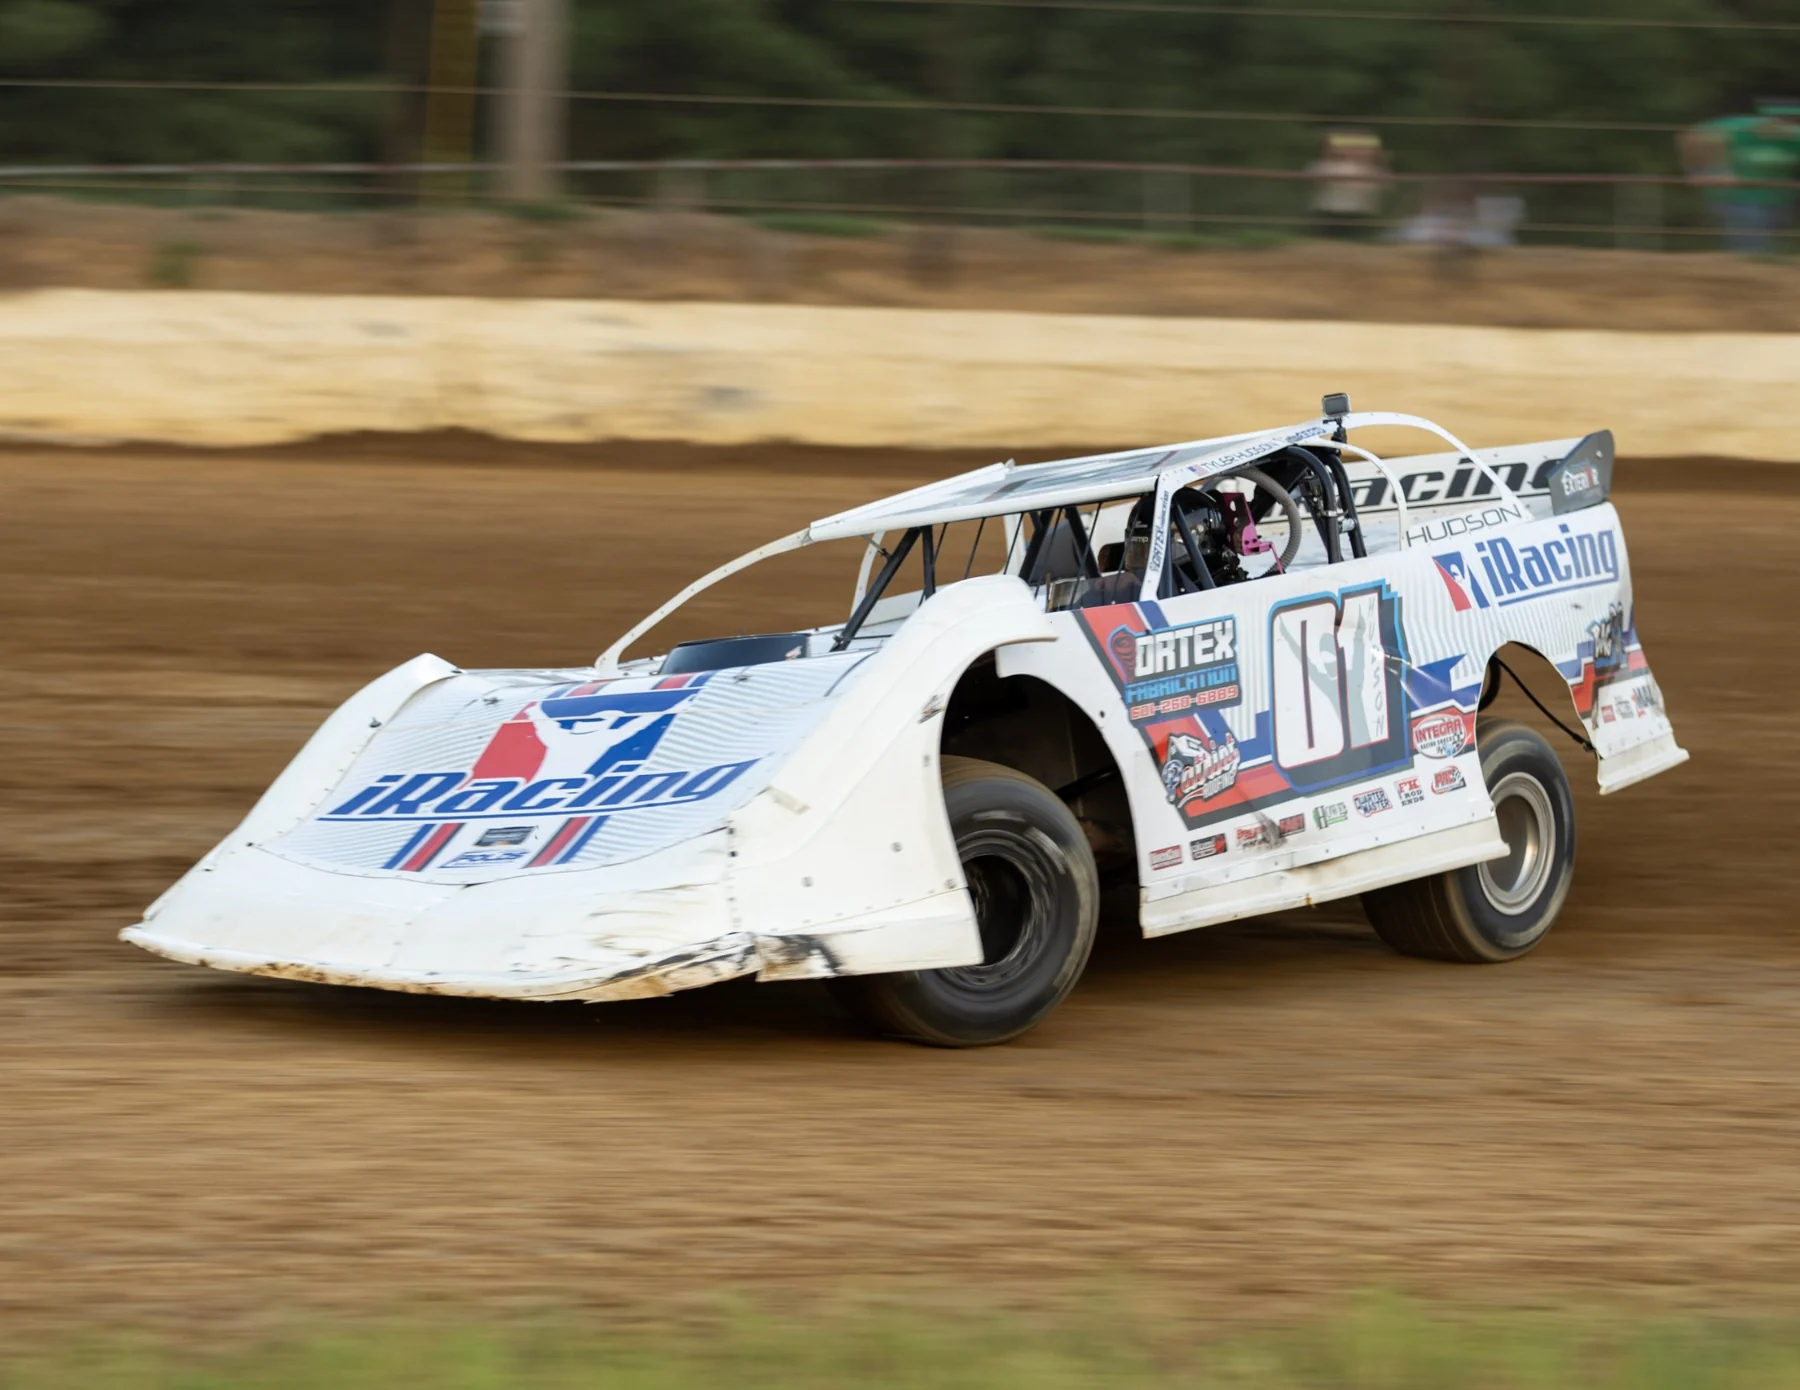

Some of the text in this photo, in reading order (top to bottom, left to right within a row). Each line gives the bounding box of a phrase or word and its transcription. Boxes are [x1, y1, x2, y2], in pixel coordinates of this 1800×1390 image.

[1405, 503, 1522, 548] HUDSON
[1474, 523, 1619, 598] iRacing
[1273, 592, 1390, 770] 01
[1130, 684, 1239, 720] 601-260-6889
[1415, 718, 1462, 744] INTEGRA
[329, 757, 764, 816] iRacing
[1398, 778, 1420, 793] FK
[1401, 796, 1425, 807] ENDS
[1404, 789, 1423, 799] ROD
